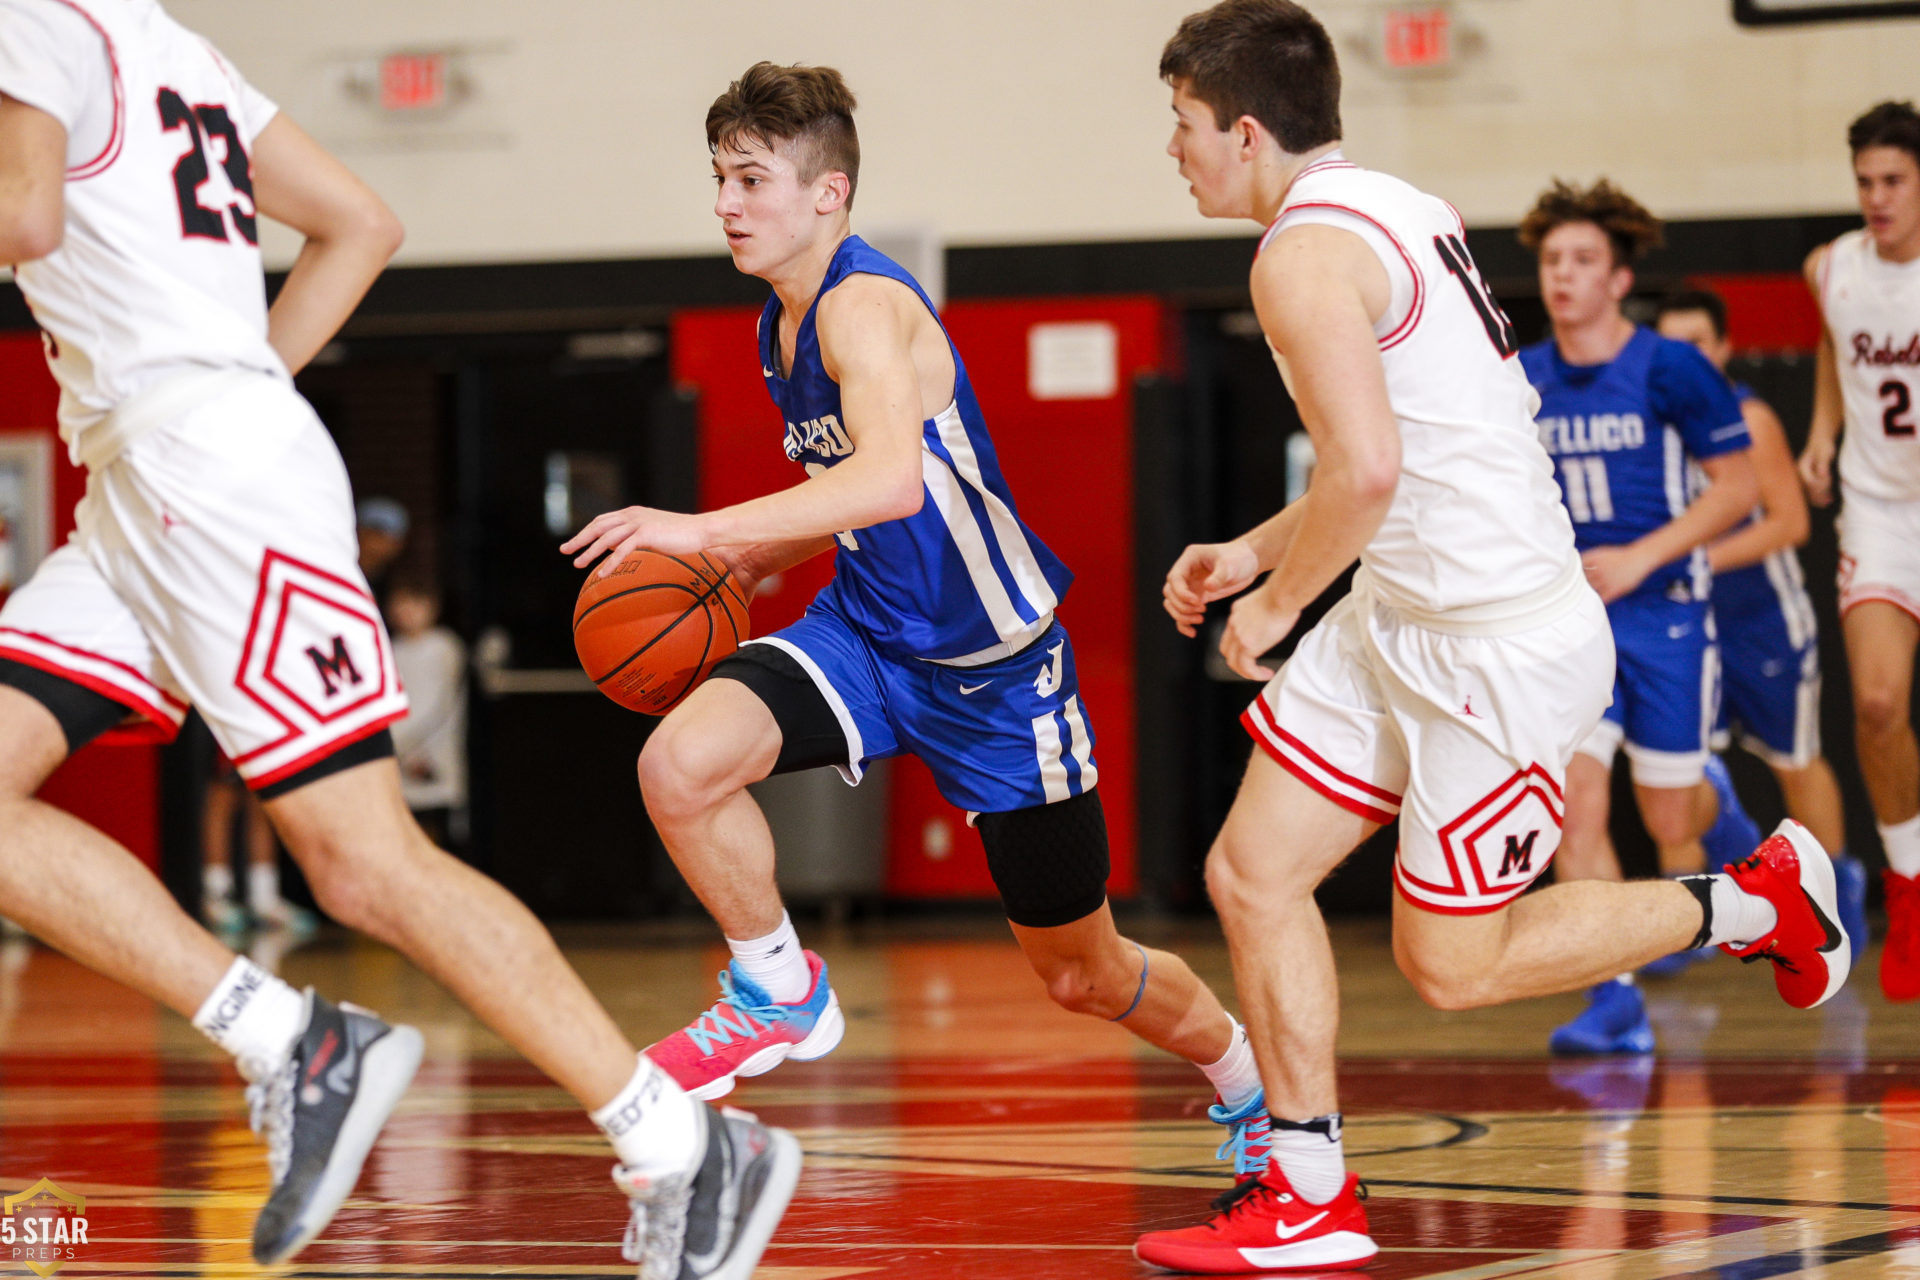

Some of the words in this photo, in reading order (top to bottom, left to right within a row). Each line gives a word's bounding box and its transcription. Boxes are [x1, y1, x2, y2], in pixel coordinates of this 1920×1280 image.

[156, 86, 259, 247] 23
[1534, 413, 1646, 455] ELLICO
[1879, 379, 1916, 438] 2
[1560, 454, 1614, 523] 11
[305, 635, 363, 697] M
[1033, 638, 1064, 698] J
[1497, 829, 1540, 878] M
